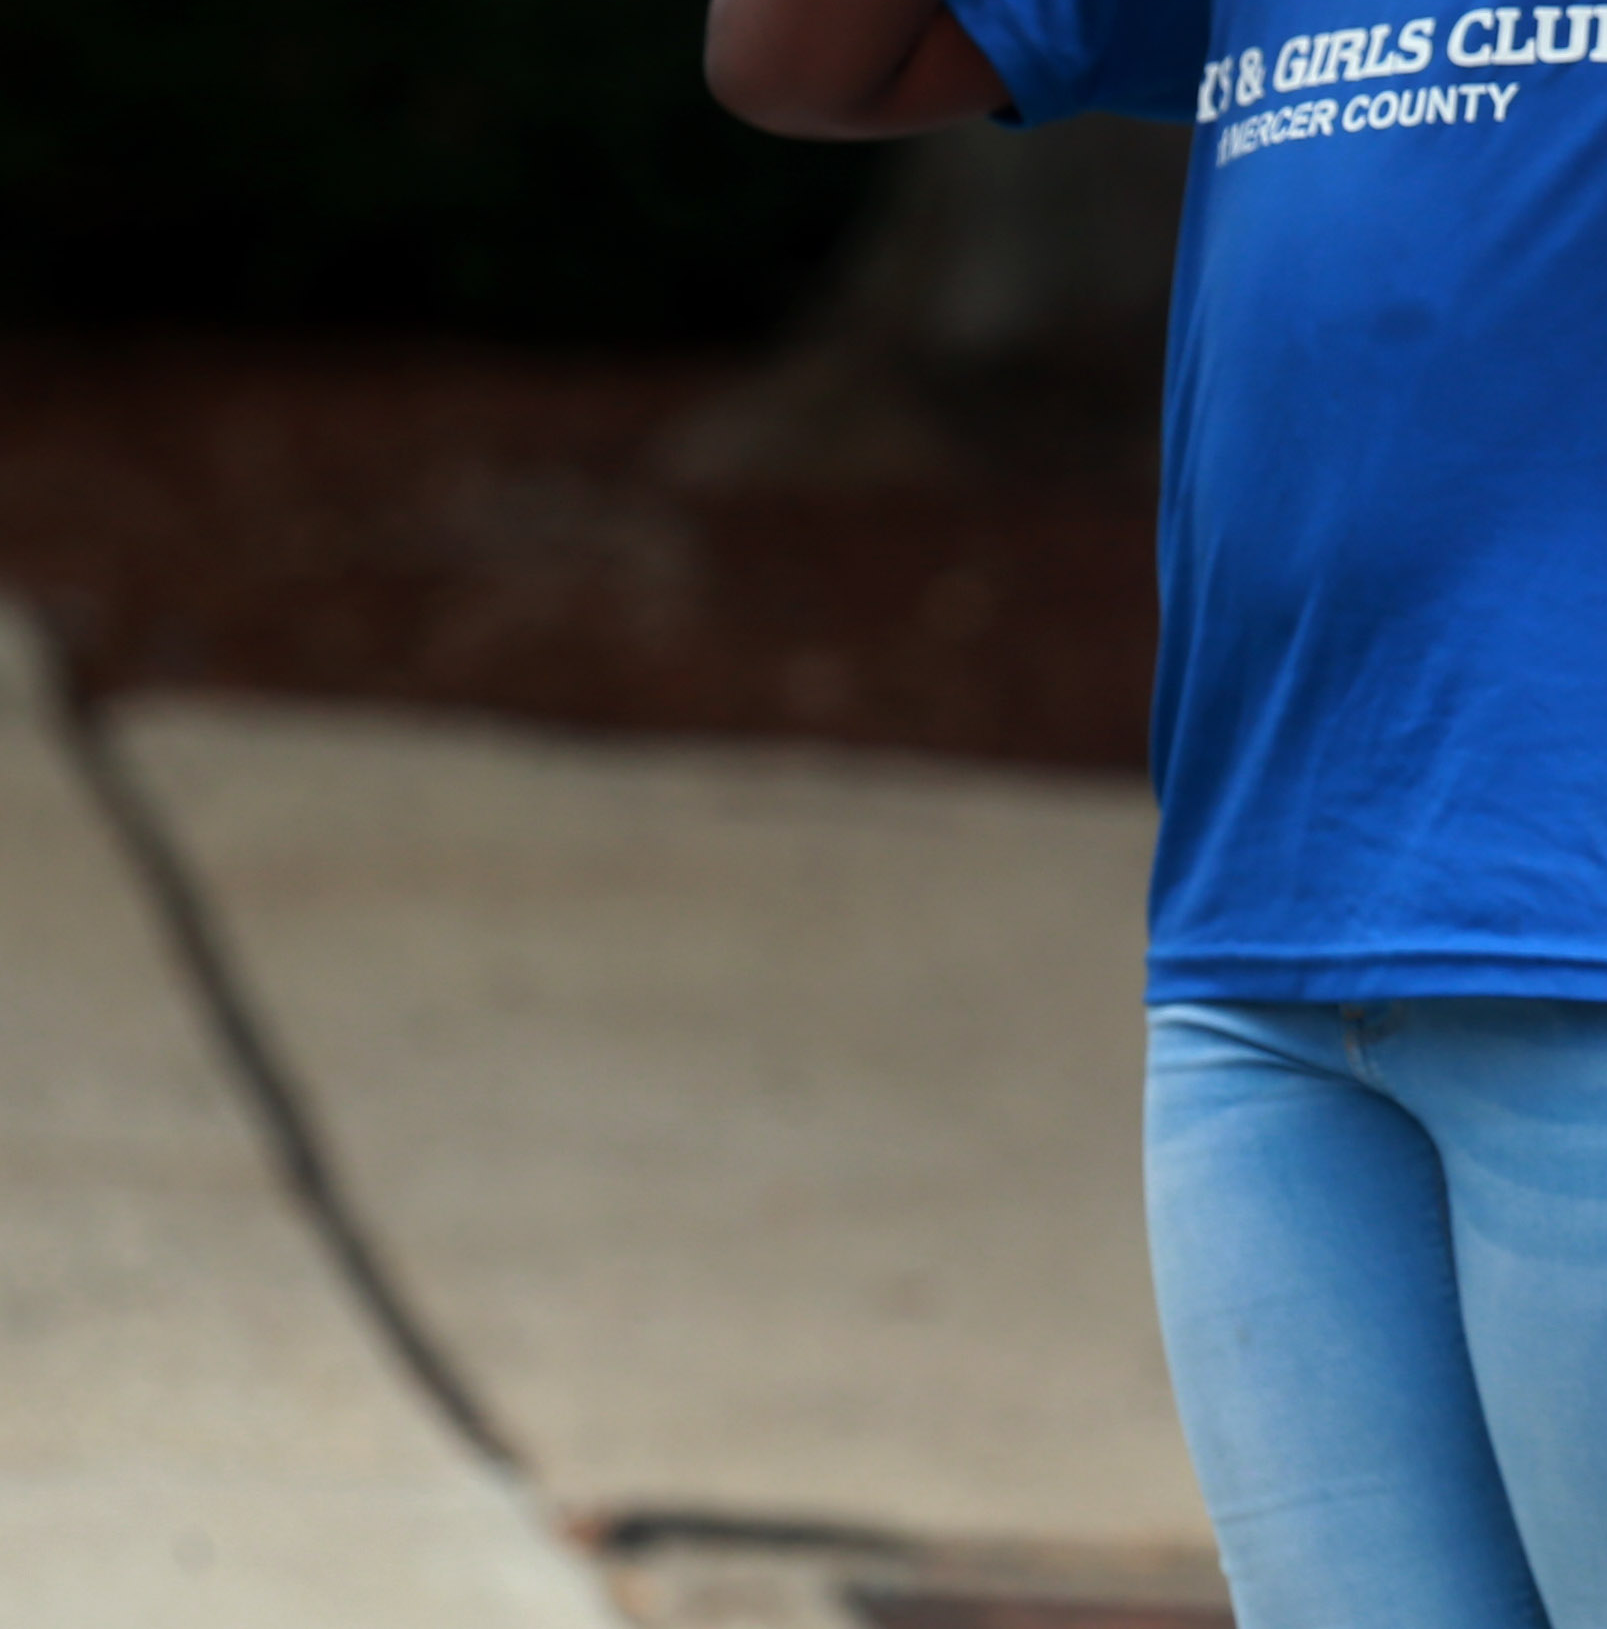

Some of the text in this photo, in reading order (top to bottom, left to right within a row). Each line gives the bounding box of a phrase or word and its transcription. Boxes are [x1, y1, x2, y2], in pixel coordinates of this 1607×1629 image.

[1235, 46, 1266, 107] &
[1273, 16, 1437, 94] GIRLS
[1342, 82, 1520, 133] COUNTY
